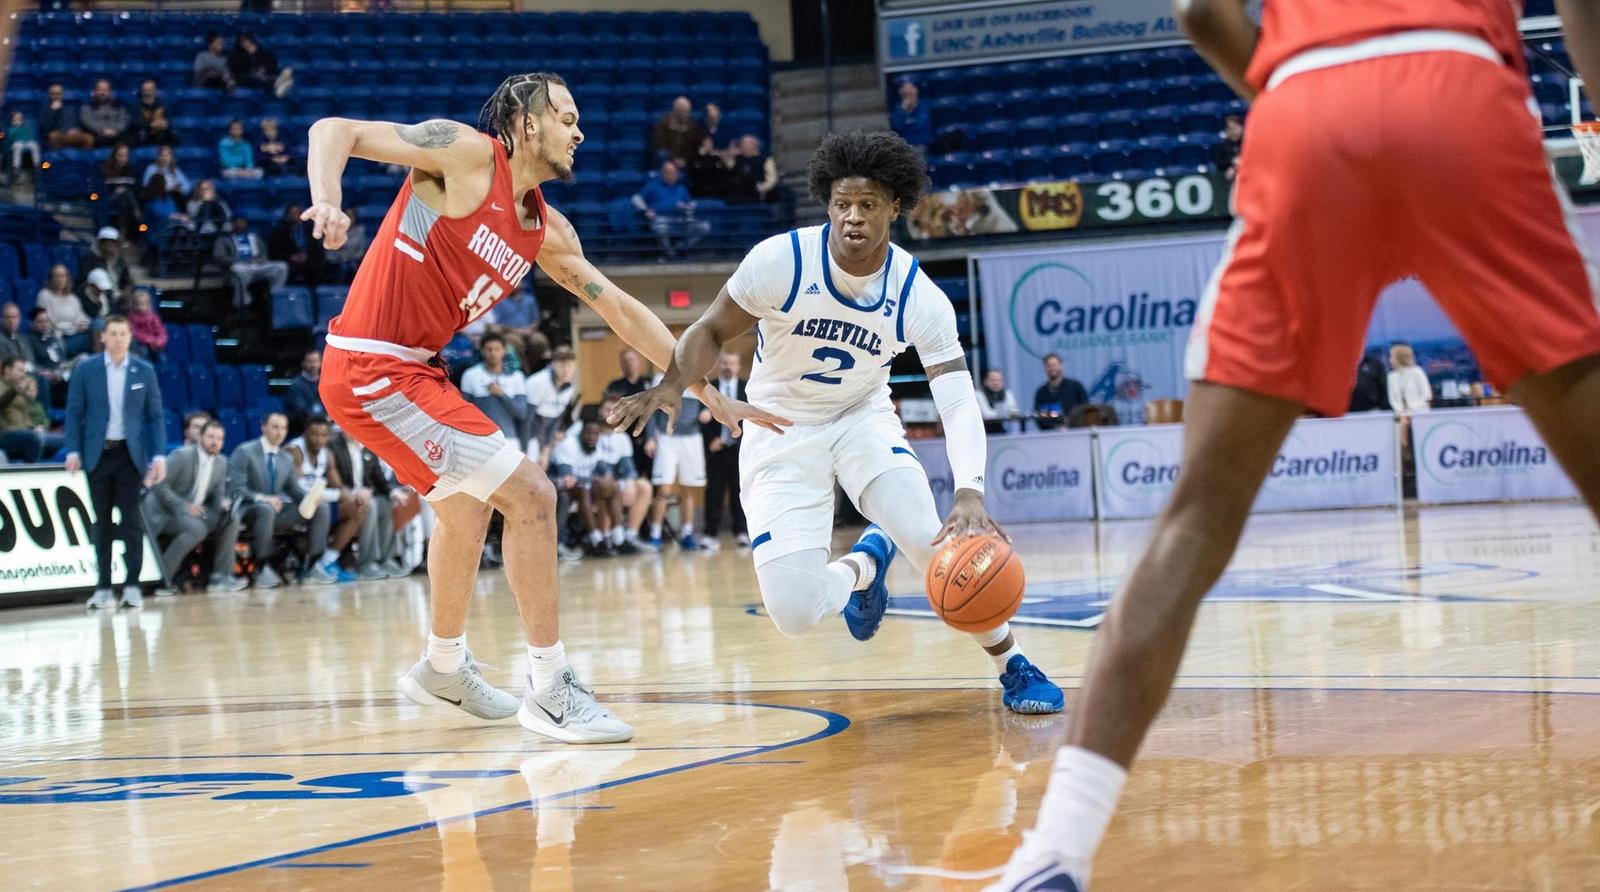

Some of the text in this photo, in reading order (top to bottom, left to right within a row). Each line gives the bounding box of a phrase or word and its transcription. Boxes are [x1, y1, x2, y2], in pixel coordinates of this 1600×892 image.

[1096, 175, 1214, 221] 360
[1033, 292, 1198, 336] Carolina
[791, 318, 882, 357] ASHEVILL
[800, 346, 856, 385] 2
[1270, 450, 1380, 477] Carolina
[1439, 441, 1547, 469] Carolina
[1001, 466, 1080, 491] Carolina
